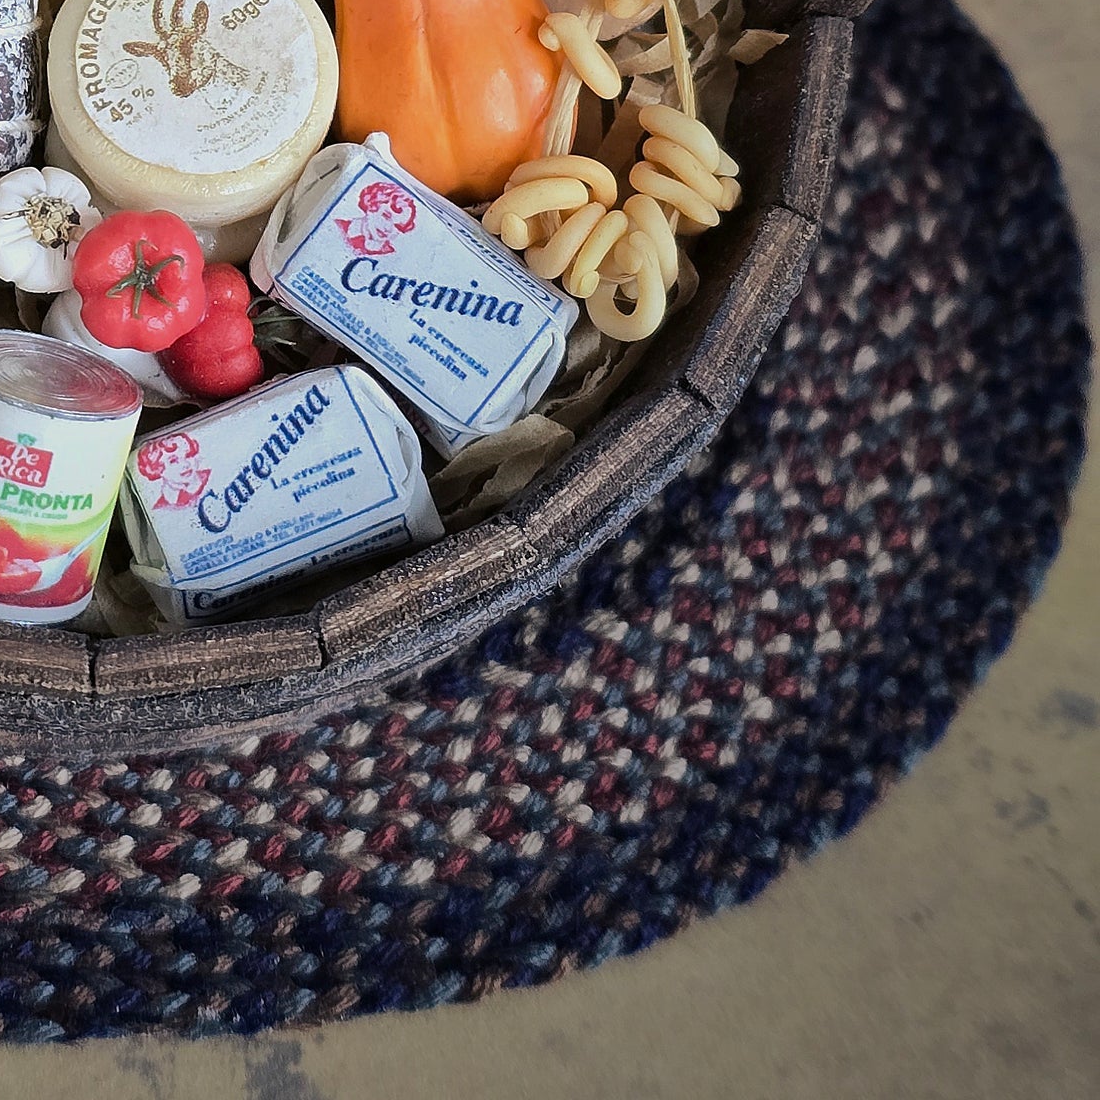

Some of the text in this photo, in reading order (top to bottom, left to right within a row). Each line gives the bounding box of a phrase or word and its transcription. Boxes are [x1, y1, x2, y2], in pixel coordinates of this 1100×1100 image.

[109, 98, 135, 125] 45
[131, 84, 155, 103] %
[340, 257, 524, 328] Carenina
[408, 309, 427, 329] La
[6, 443, 40, 467] De
[197, 384, 332, 533] Carenina
[271, 476, 289, 490] La
